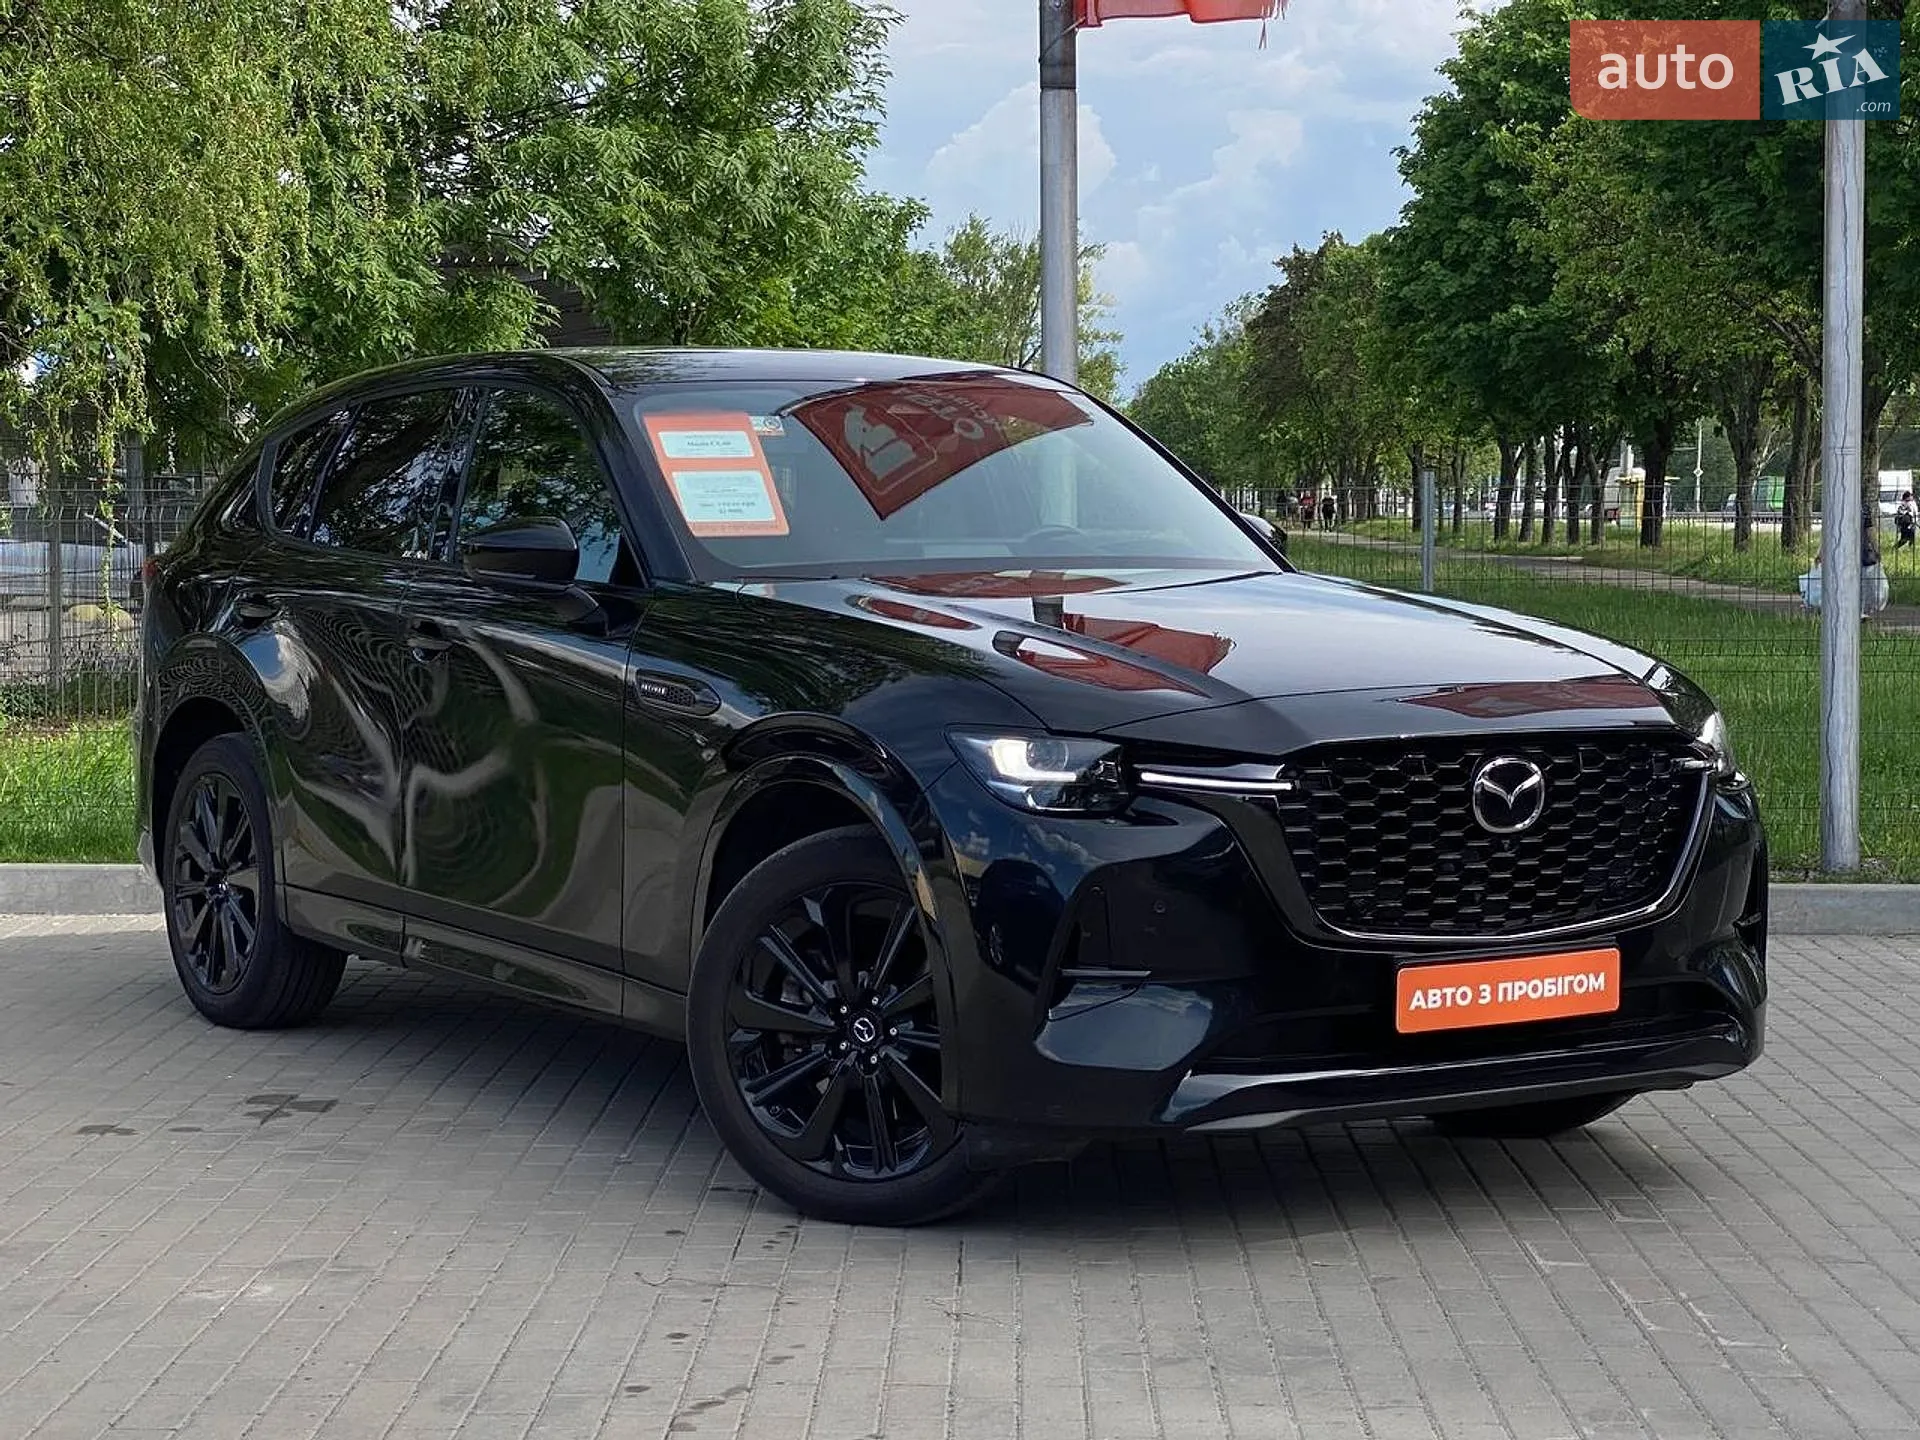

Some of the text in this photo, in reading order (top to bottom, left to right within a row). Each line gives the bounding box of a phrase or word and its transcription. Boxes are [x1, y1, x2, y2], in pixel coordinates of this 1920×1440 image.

[1409, 972, 1605, 1011] АВТО З ПРОБІГОМ
